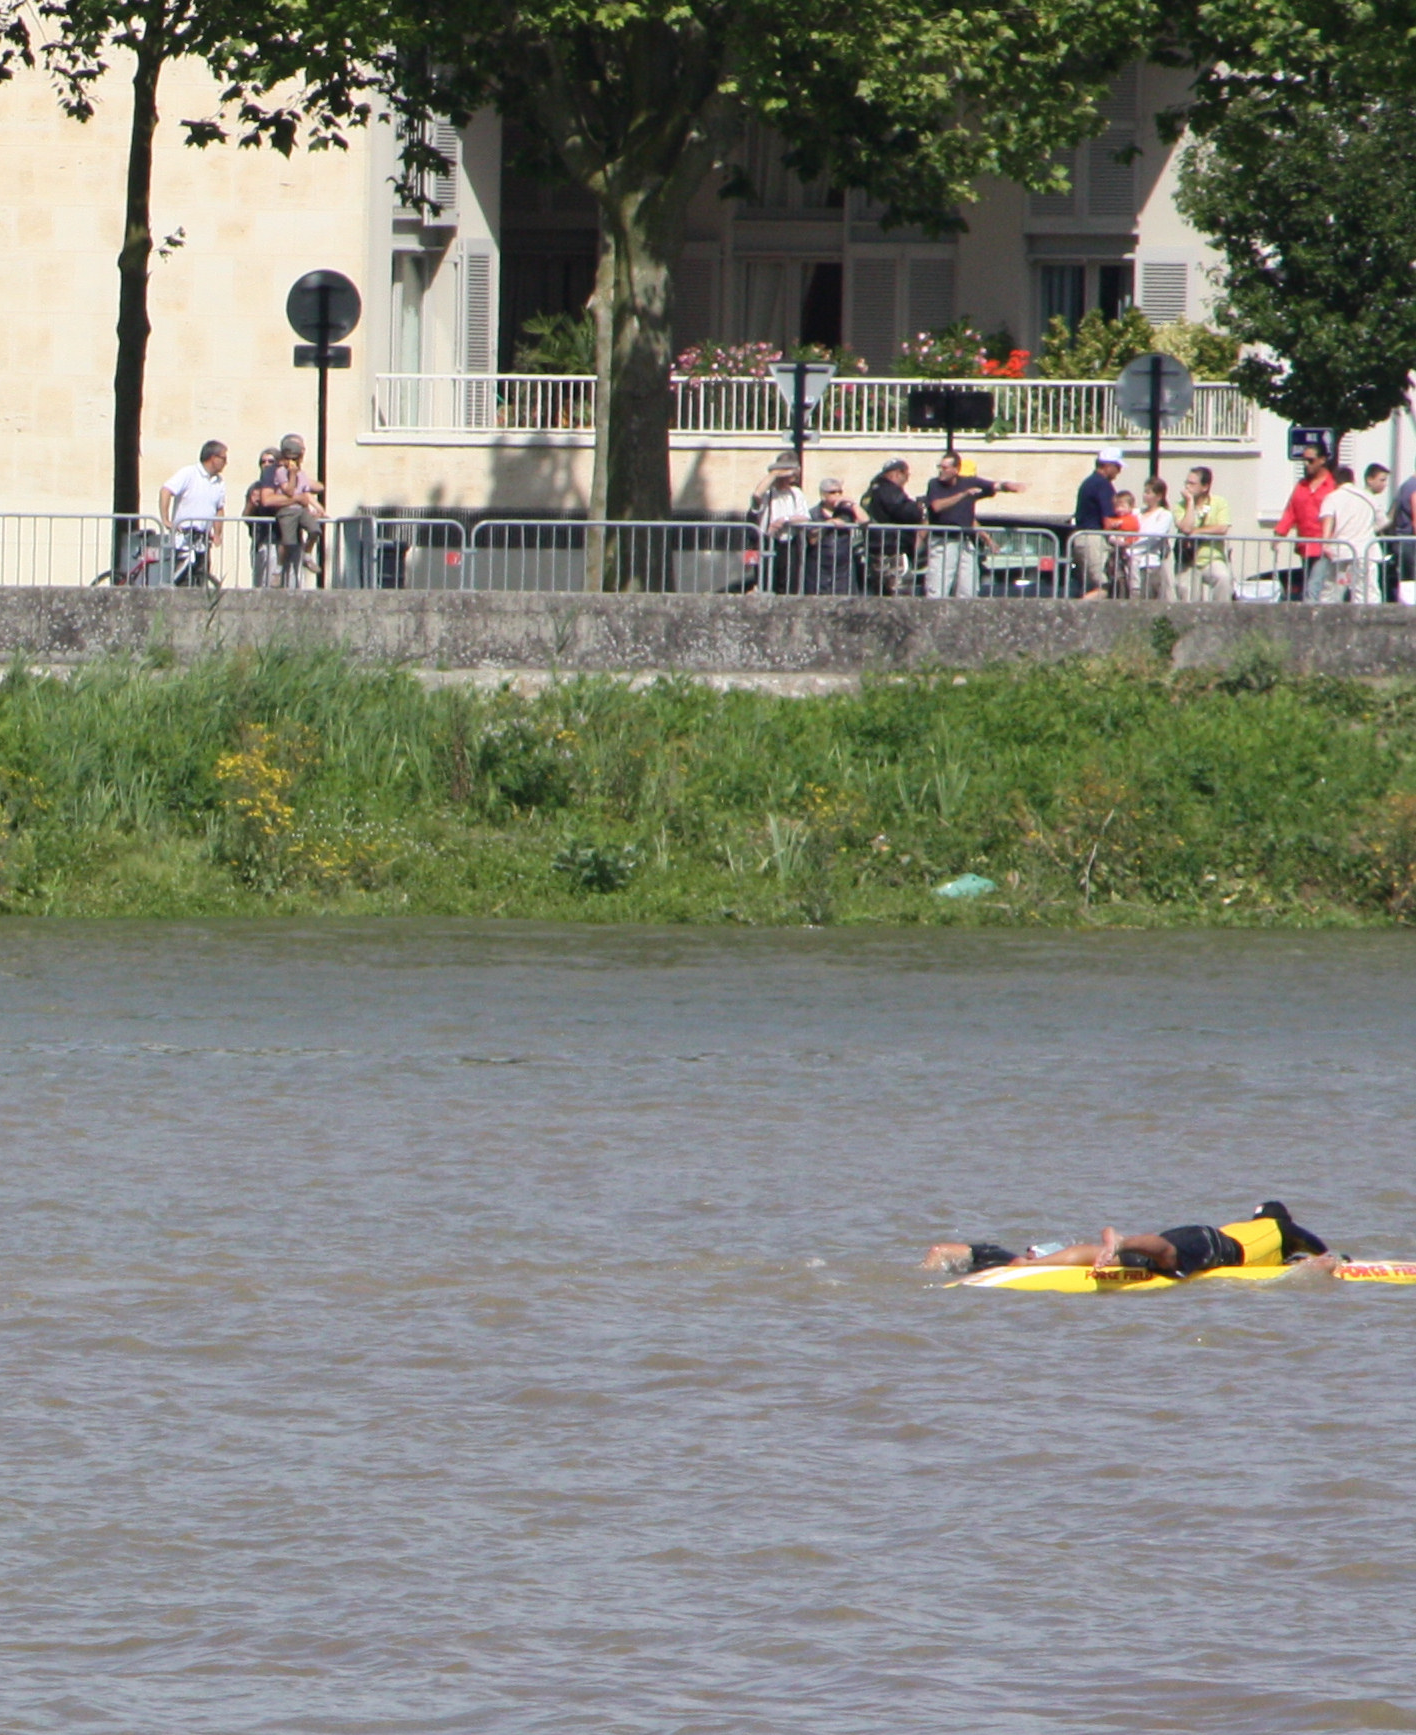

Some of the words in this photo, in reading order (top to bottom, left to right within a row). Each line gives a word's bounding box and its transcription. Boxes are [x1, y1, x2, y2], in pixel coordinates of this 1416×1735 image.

[1085, 1270, 1120, 1281] FORCE
[1123, 1270, 1154, 1281] FIELD
[1340, 1265, 1388, 1279] FORCE
